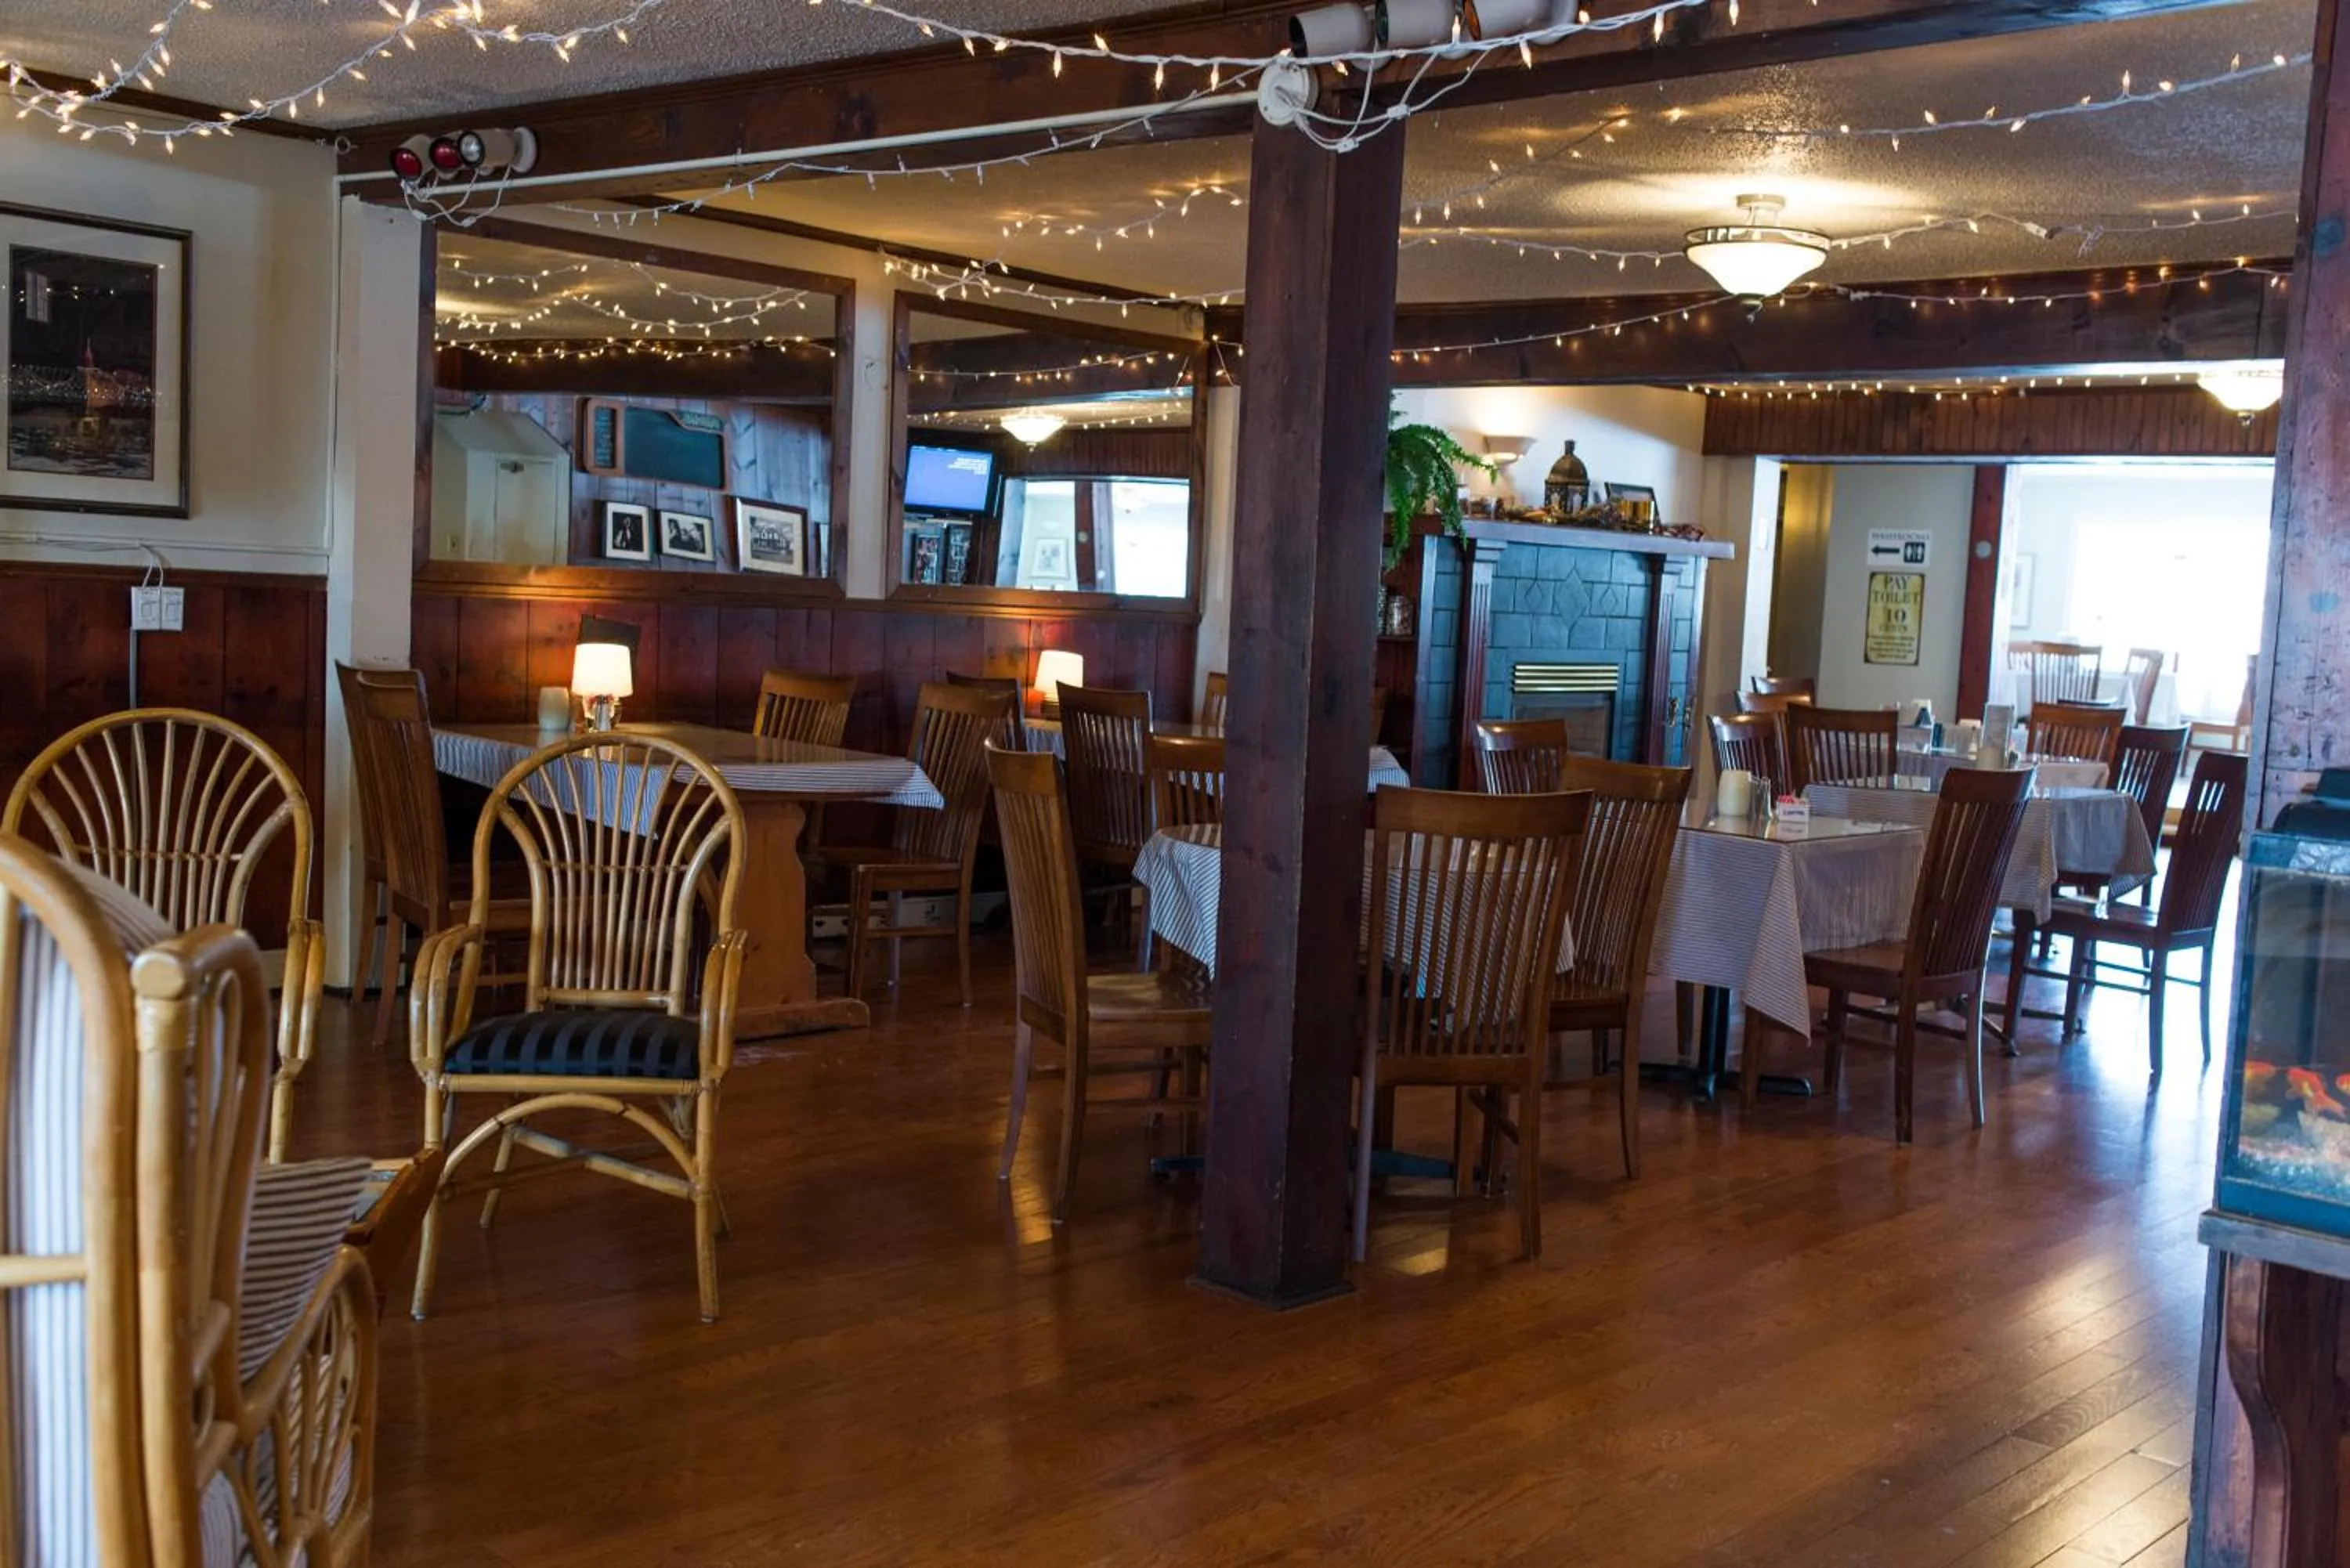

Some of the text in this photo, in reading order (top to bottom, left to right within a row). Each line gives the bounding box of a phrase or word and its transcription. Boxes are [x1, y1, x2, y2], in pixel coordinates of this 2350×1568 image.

[1883, 575, 1911, 590] PAY
[1872, 591, 1919, 605] TOILET
[1885, 608, 1907, 623] 10
